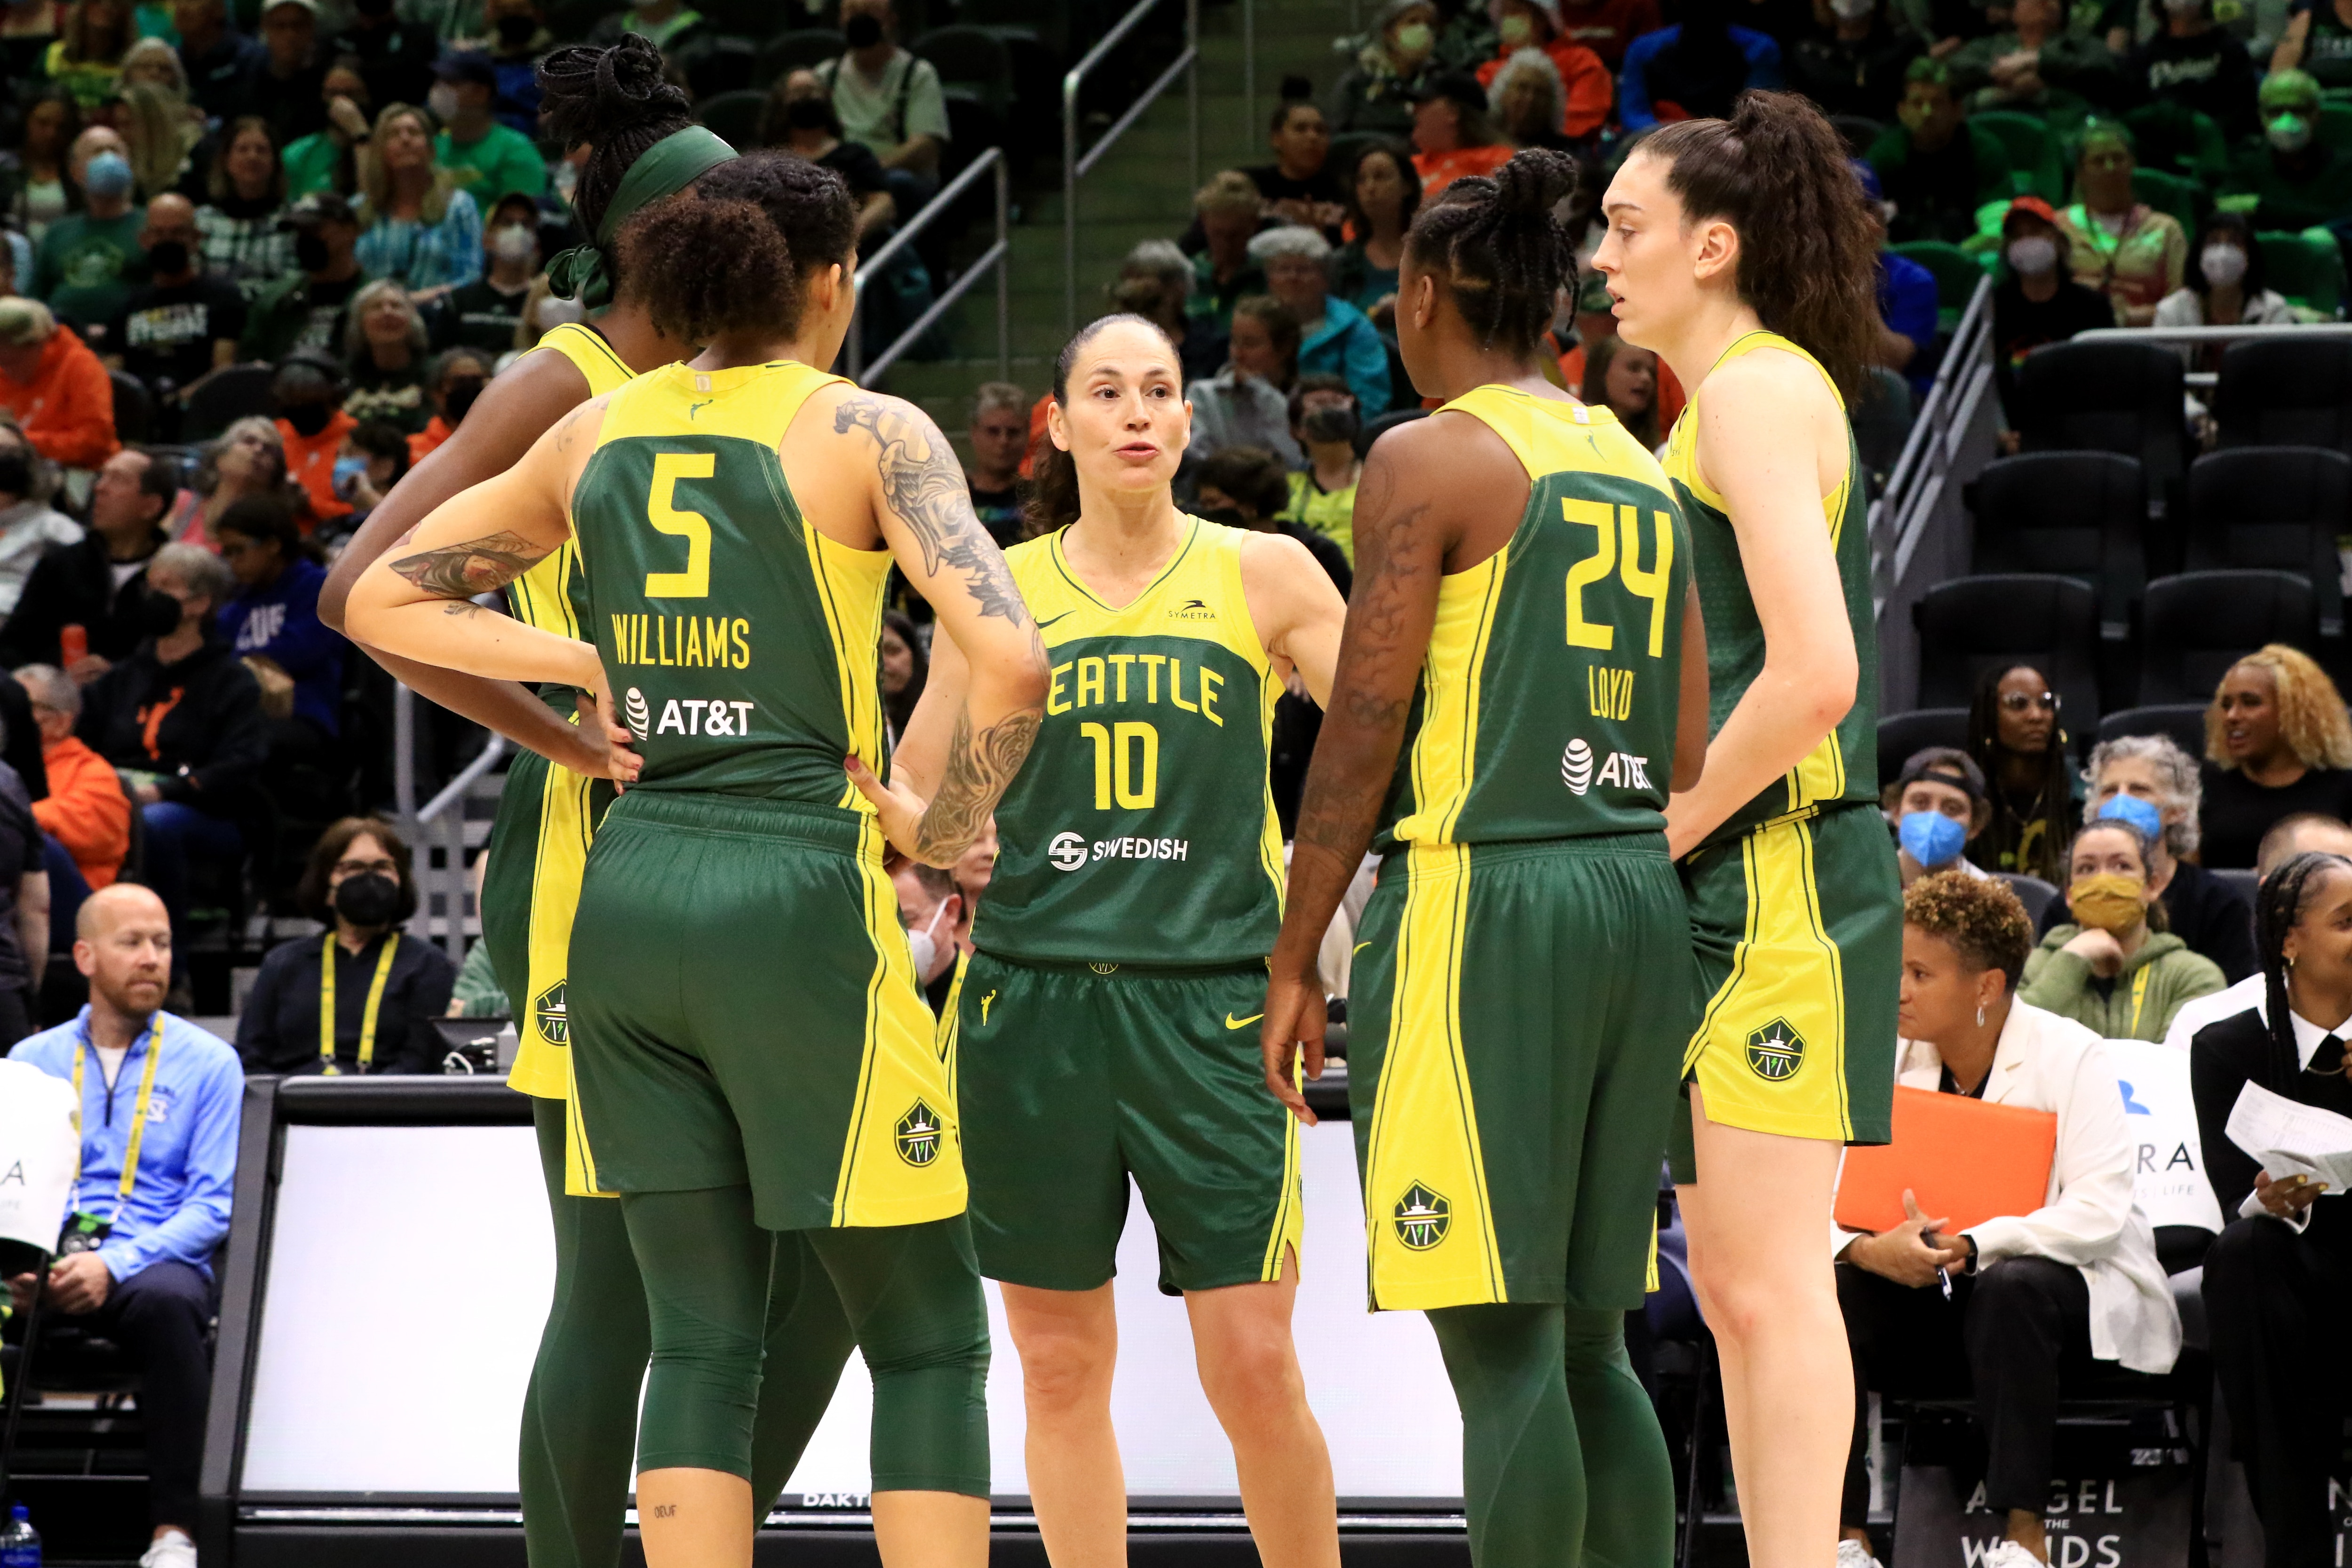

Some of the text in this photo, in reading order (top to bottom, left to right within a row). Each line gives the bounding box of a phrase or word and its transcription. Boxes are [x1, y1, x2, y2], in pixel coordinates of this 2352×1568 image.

[644, 453, 715, 597] 5
[1561, 497, 1674, 658] 24
[1168, 611, 1216, 619] SYMETRA
[612, 614, 750, 669] WILLIAMS
[1040, 654, 1224, 727] EATTLE
[1588, 665, 1634, 721] LOYD
[657, 700, 754, 736] AT&T
[1081, 722, 1159, 810] 10
[1596, 752, 1652, 789] AT&T
[1092, 837, 1189, 861] SWEDISH
[803, 1493, 871, 1507] DAKT
[1965, 1479, 2123, 1514] AGEL
[2044, 1519, 2070, 1530] THE
[1961, 1534, 2122, 1568] WDS
